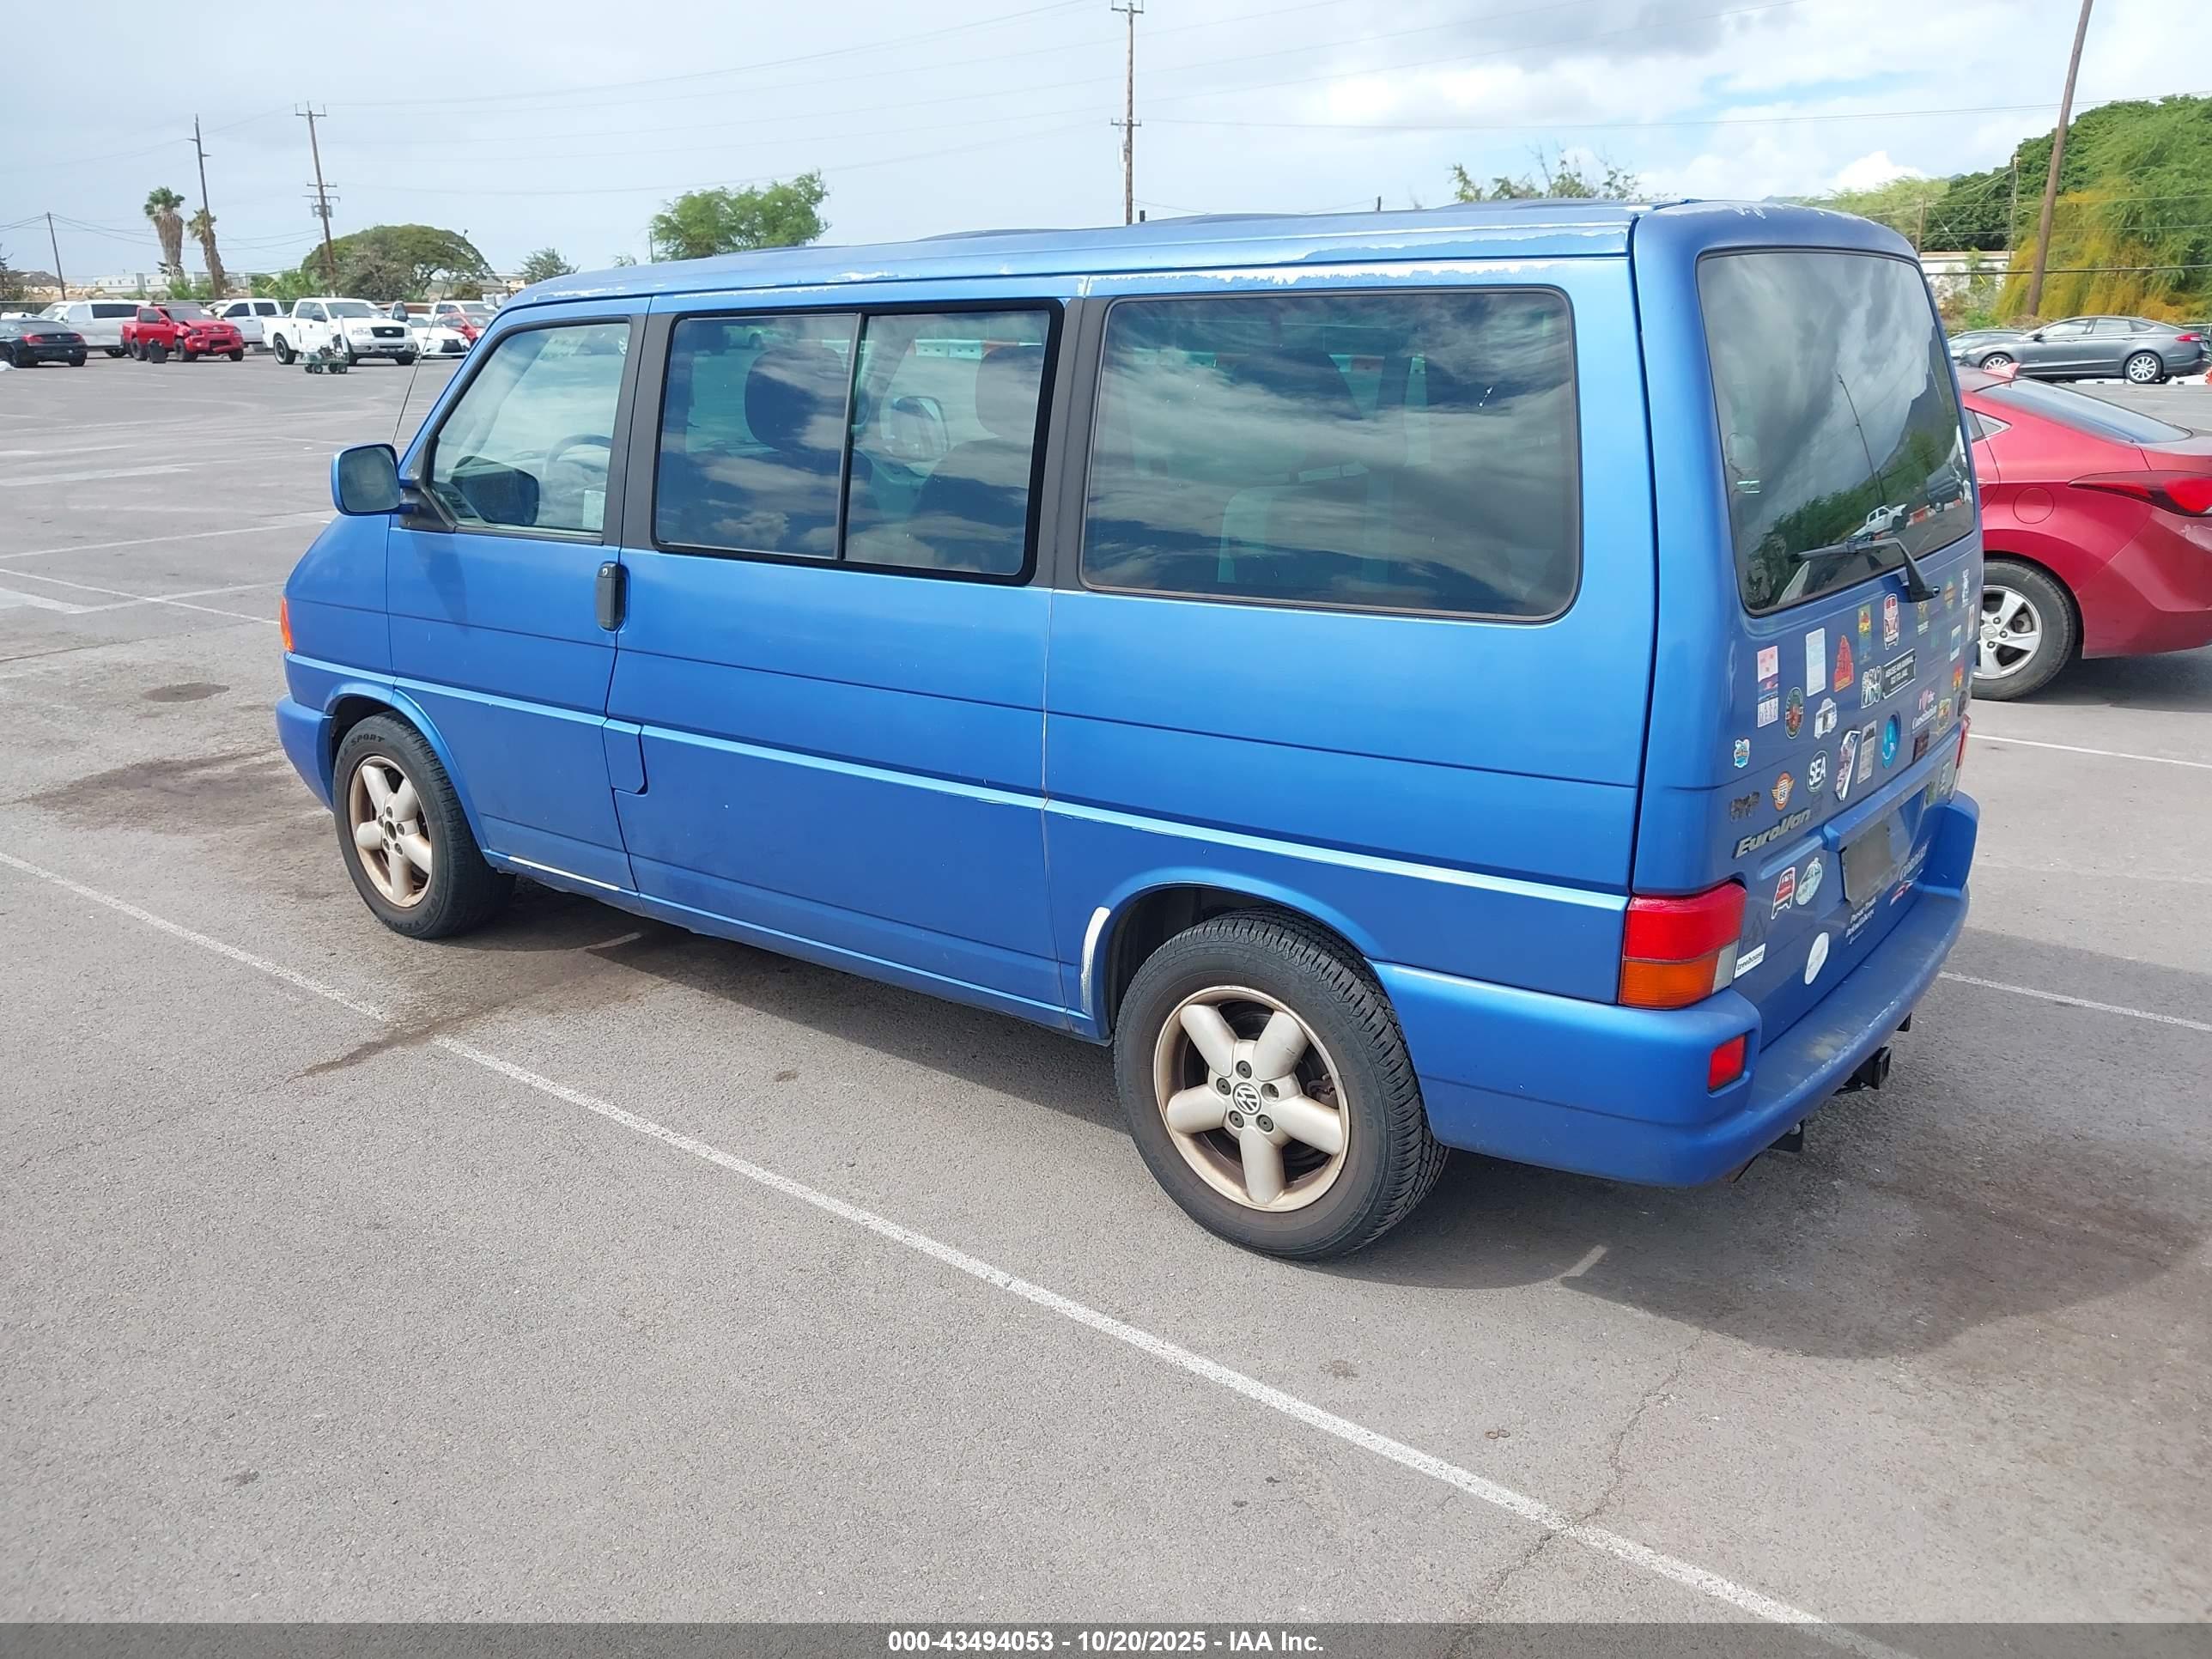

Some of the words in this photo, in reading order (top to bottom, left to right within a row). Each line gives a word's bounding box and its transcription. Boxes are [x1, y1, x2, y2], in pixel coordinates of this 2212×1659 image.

[350, 733, 386, 746] SPORT
[1809, 756, 1826, 786] SEA
[1735, 809, 1812, 859] EuroVan
